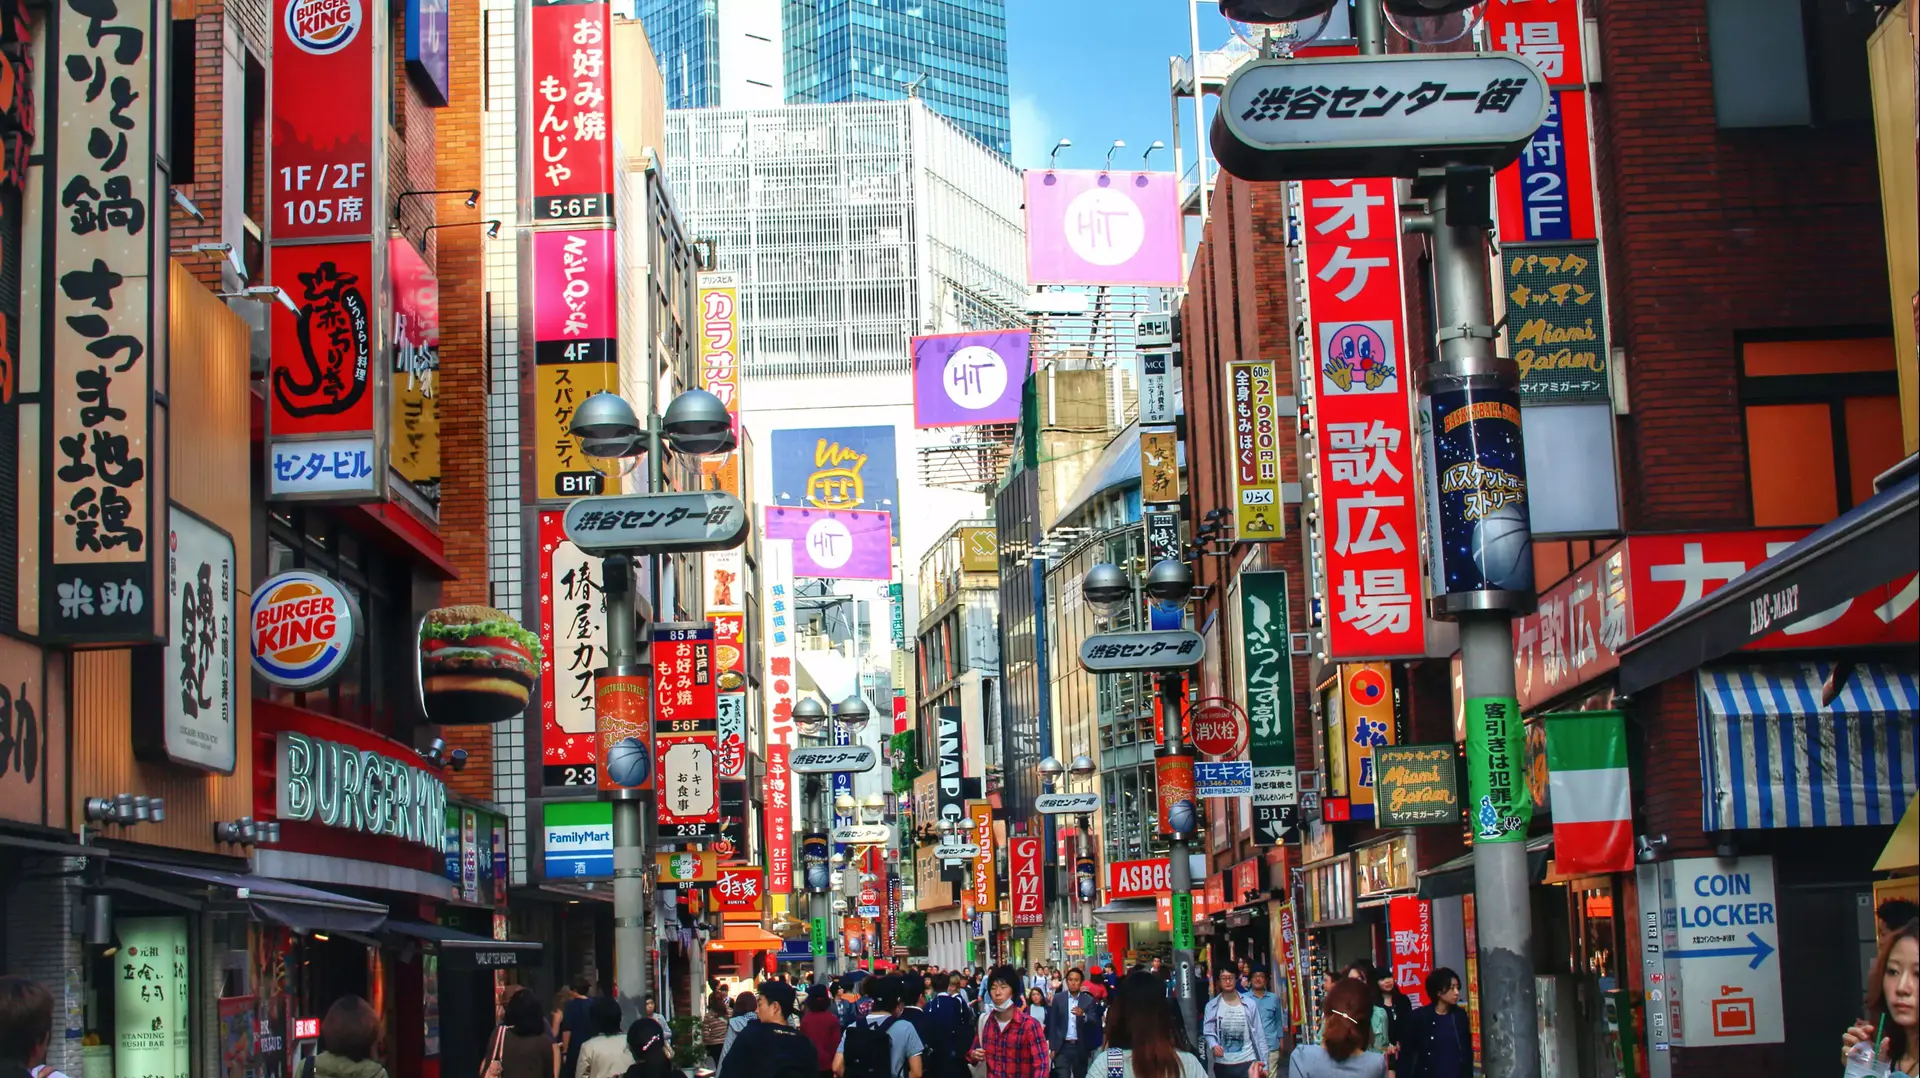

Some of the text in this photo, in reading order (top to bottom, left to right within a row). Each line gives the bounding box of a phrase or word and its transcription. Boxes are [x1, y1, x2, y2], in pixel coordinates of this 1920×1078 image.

[298, 6, 353, 41] KING
[571, 17, 607, 143] お好み焼
[1240, 77, 1529, 122] 渋谷センター街
[537, 74, 573, 188] もんじゃ
[282, 195, 365, 226] 105席
[1509, 252, 1590, 277] パスタ
[1509, 282, 1596, 309] キッチン
[1514, 317, 1598, 345] Miami
[563, 342, 591, 362] 4F
[1144, 360, 1166, 370] MCC
[1252, 365, 1271, 378] 60分
[57, 258, 145, 553] さつま地鶏
[553, 368, 575, 469] スパゲッティ
[1234, 369, 1255, 483] 全身もみほぐし
[273, 448, 374, 483] センタービル
[572, 504, 735, 534] 渋谷センター街
[1325, 418, 1413, 638] 歌広場
[55, 576, 144, 621] 米助
[1749, 582, 1800, 636] ABC-MART
[255, 596, 336, 632] BURGER
[256, 613, 339, 659] KING
[669, 629, 698, 641] 85席
[1086, 638, 1199, 660] 渋谷センター街
[675, 643, 694, 707] お好み焼
[694, 644, 710, 685] 江戸前
[657, 661, 675, 720] もんじゃ
[1195, 720, 1236, 742] 消火栓
[792, 751, 870, 766] 渋谷センター街
[937, 717, 961, 798] ANAP
[286, 730, 411, 842] BURGER
[690, 747, 704, 798] ケーキと
[1252, 769, 1293, 779] レモンステーキ
[1253, 780, 1293, 790] ねぎ塩焼き
[1381, 765, 1442, 787] Miami
[676, 773, 690, 812] お食事
[1038, 797, 1099, 809] 渋谷センター街
[1259, 807, 1292, 820] B1F
[1390, 809, 1451, 821] マイアミガーデン
[548, 830, 611, 847] FamilyMart
[773, 848, 787, 858] 2F
[773, 862, 788, 872] 3F
[573, 861, 586, 876] 酒
[773, 876, 788, 886] 4F
[1016, 839, 1040, 912] GAME
[716, 870, 758, 901] すき家
[1692, 872, 1752, 898] COIN
[1647, 912, 1659, 940] RULER
[1680, 900, 1776, 929] LOCKER
[1418, 901, 1431, 973] カラオケルーム
[121, 1032, 166, 1041] STANDING
[121, 1040, 147, 1049] SUSHI
[148, 1040, 166, 1048] BAR
[260, 1035, 283, 1053] VALUE
